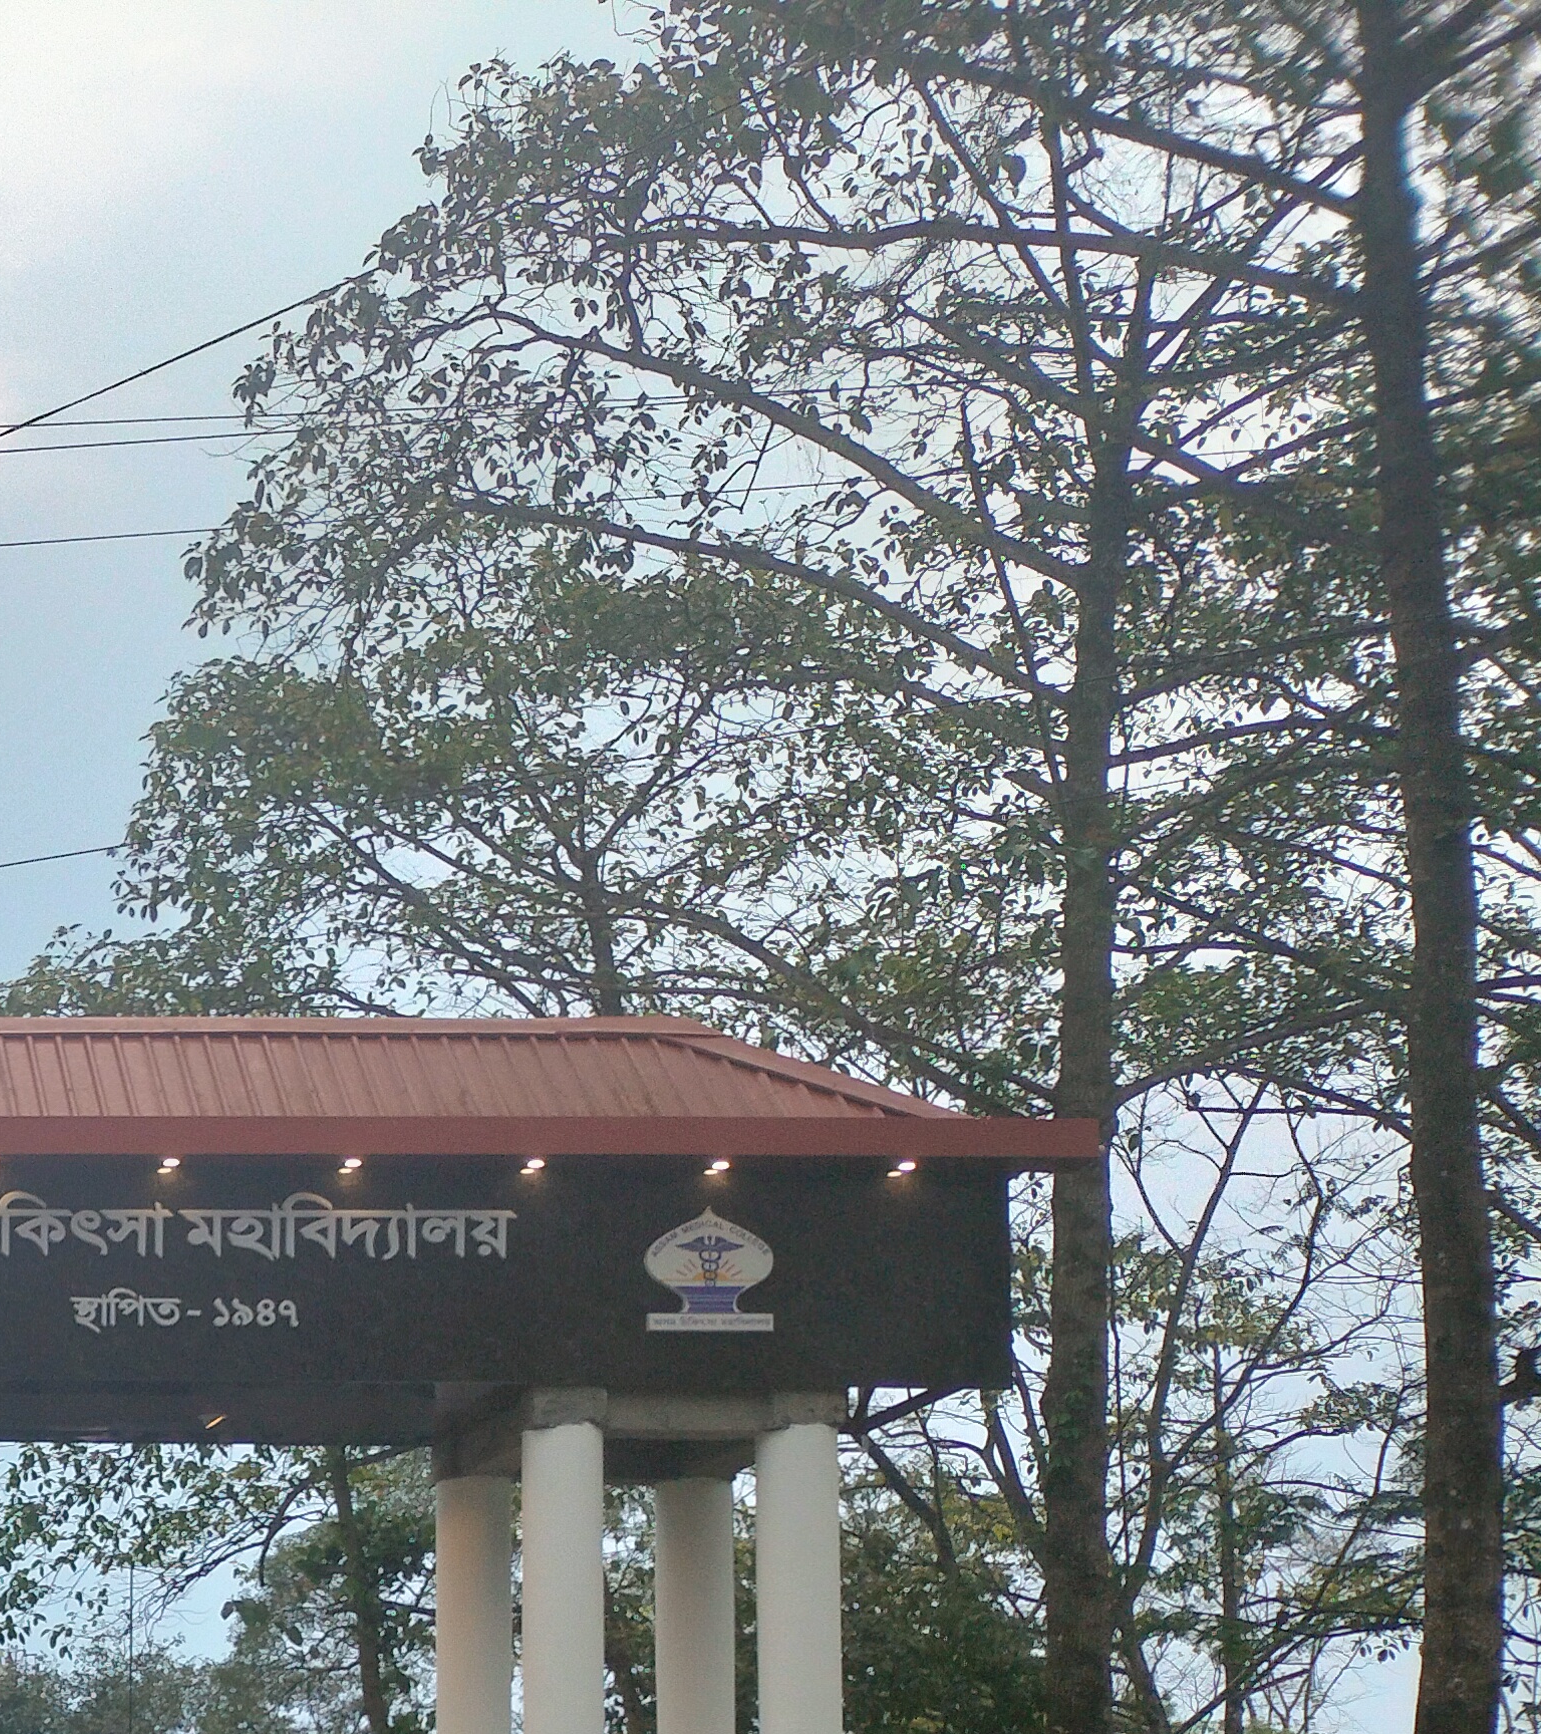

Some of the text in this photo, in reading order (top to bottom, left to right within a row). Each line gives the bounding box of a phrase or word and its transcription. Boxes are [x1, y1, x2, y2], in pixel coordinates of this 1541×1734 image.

[178, 1192, 517, 1260] মহাবিদ্যালয়
[70, 1288, 181, 1333] স্থাপিত
[213, 1298, 300, 1328] ১৯৪৭
